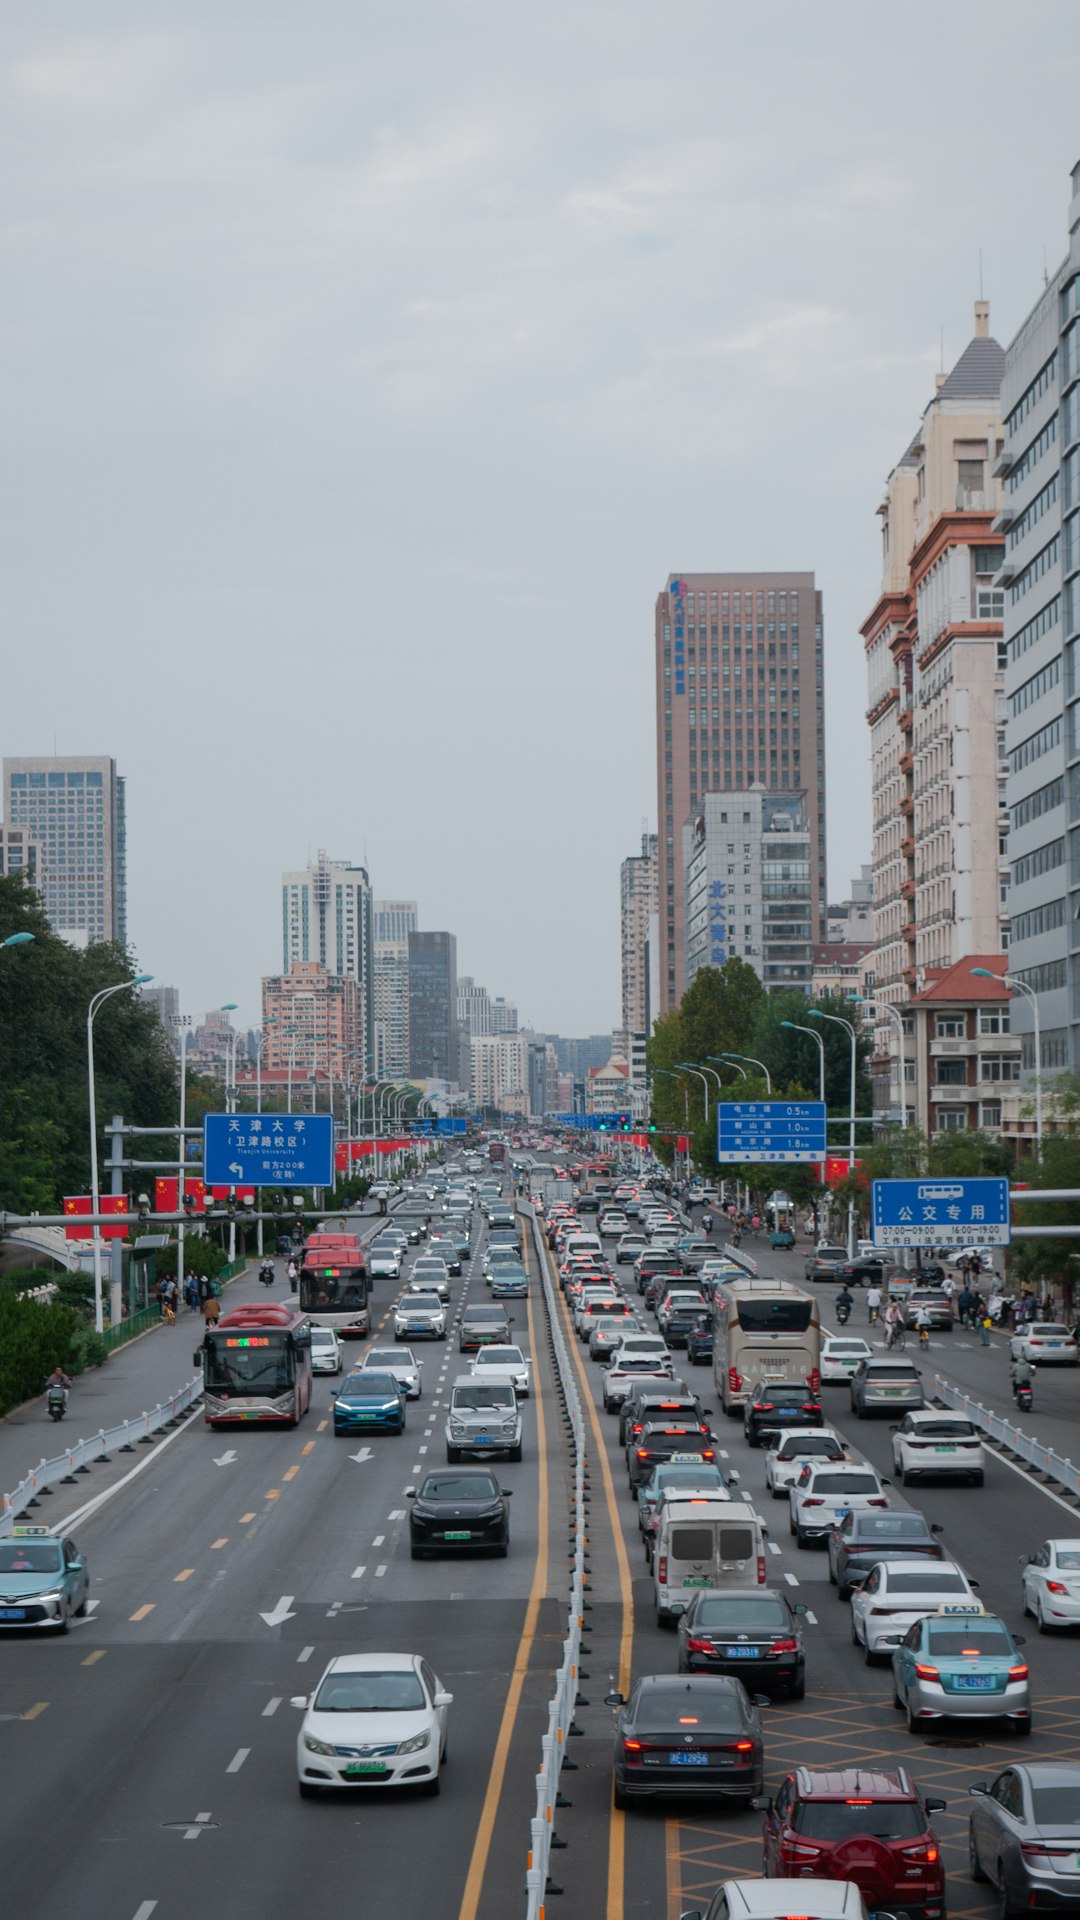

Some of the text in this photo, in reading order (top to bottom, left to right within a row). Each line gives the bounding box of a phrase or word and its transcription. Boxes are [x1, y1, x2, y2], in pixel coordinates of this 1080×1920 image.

[708, 880, 727, 965] 北大青鸟
[228, 1119, 305, 1132] 天津大学
[237, 1148, 295, 1156] Tianjin University
[262, 1161, 305, 1170] 前方200米
[898, 1204, 985, 1221] 公交专用
